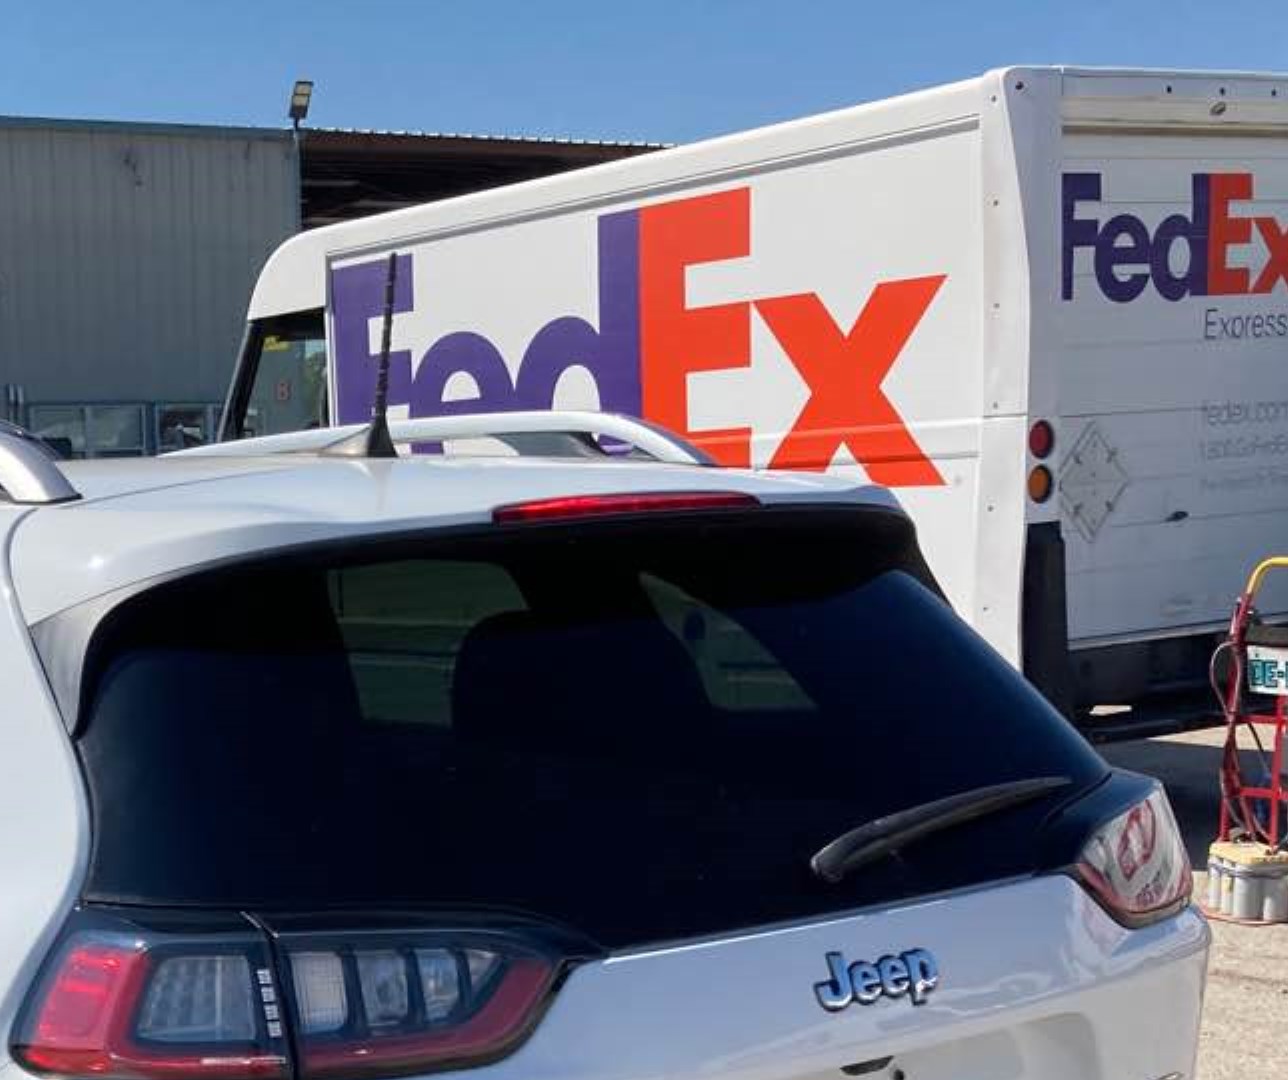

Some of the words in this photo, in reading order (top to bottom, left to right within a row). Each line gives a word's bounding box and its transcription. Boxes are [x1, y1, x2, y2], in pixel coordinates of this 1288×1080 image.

[1062, 173, 1288, 303] FedEx
[331, 187, 946, 486] FedEx
[1205, 308, 1288, 340] Express
[813, 947, 939, 1012] Jeep
